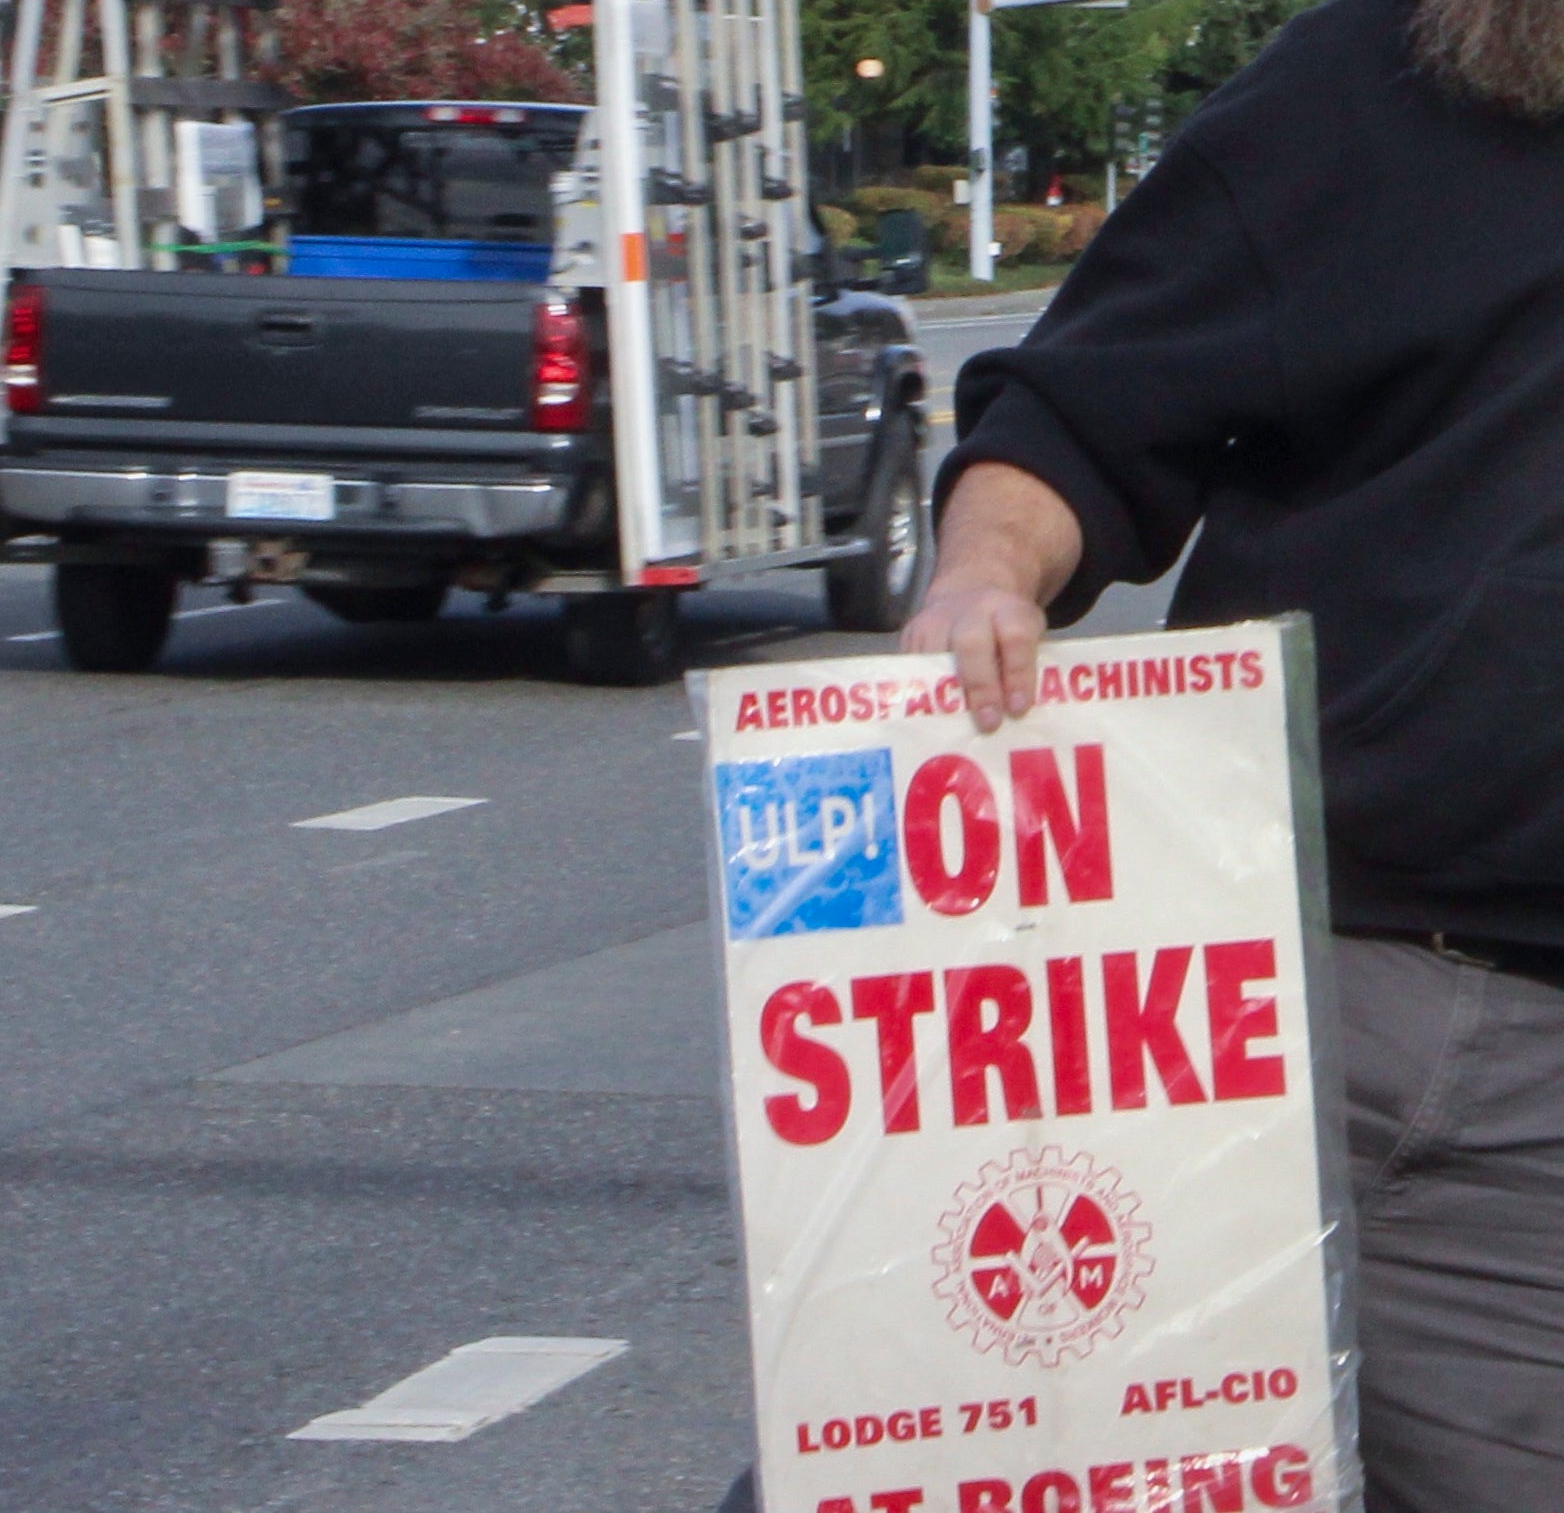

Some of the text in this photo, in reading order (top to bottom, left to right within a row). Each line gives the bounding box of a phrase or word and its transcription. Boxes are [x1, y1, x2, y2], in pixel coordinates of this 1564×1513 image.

[734, 650, 1265, 732] AEROSPAC ACHINISTS
[737, 742, 1115, 917] ULP! ON
[758, 937, 1288, 1146] STRIKE
[797, 1395, 1039, 1456] LODGE 751
[1120, 1367, 1298, 1417] AFL-CIO
